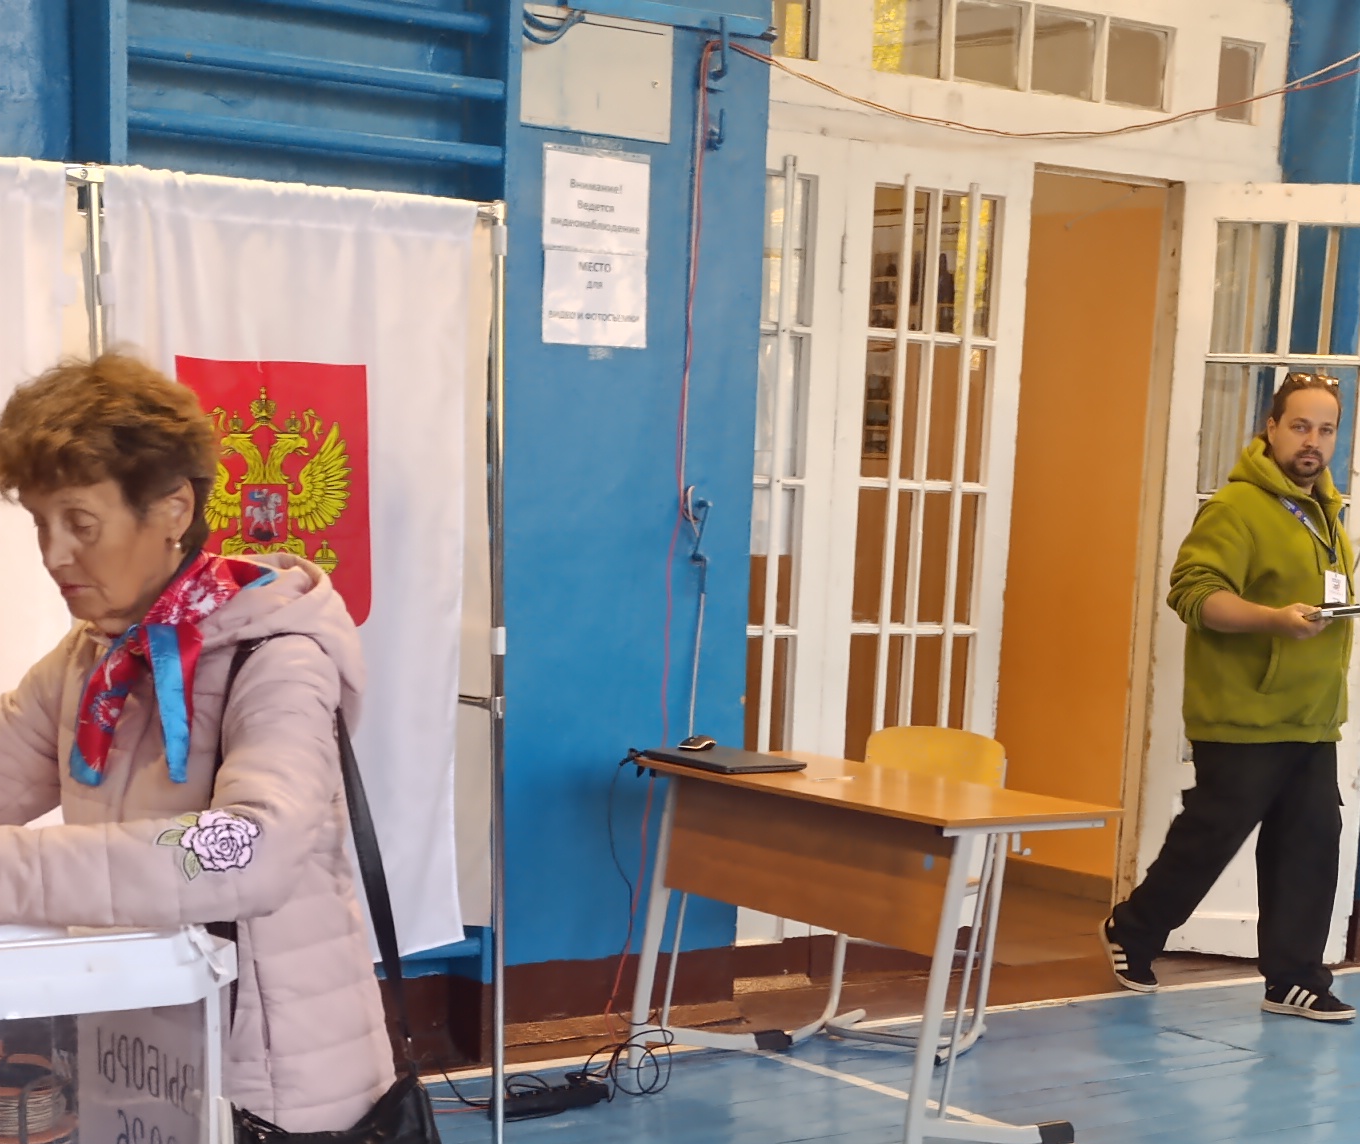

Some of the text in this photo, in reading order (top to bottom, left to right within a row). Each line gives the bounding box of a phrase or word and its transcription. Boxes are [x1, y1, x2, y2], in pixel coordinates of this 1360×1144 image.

[570, 178, 623, 195] Внимание!
[577, 199, 615, 213] Ведется
[550, 217, 640, 235] видеонаблюдение
[578, 261, 611, 273] МЕСТО
[548, 310, 577, 320] ВИДЕО
